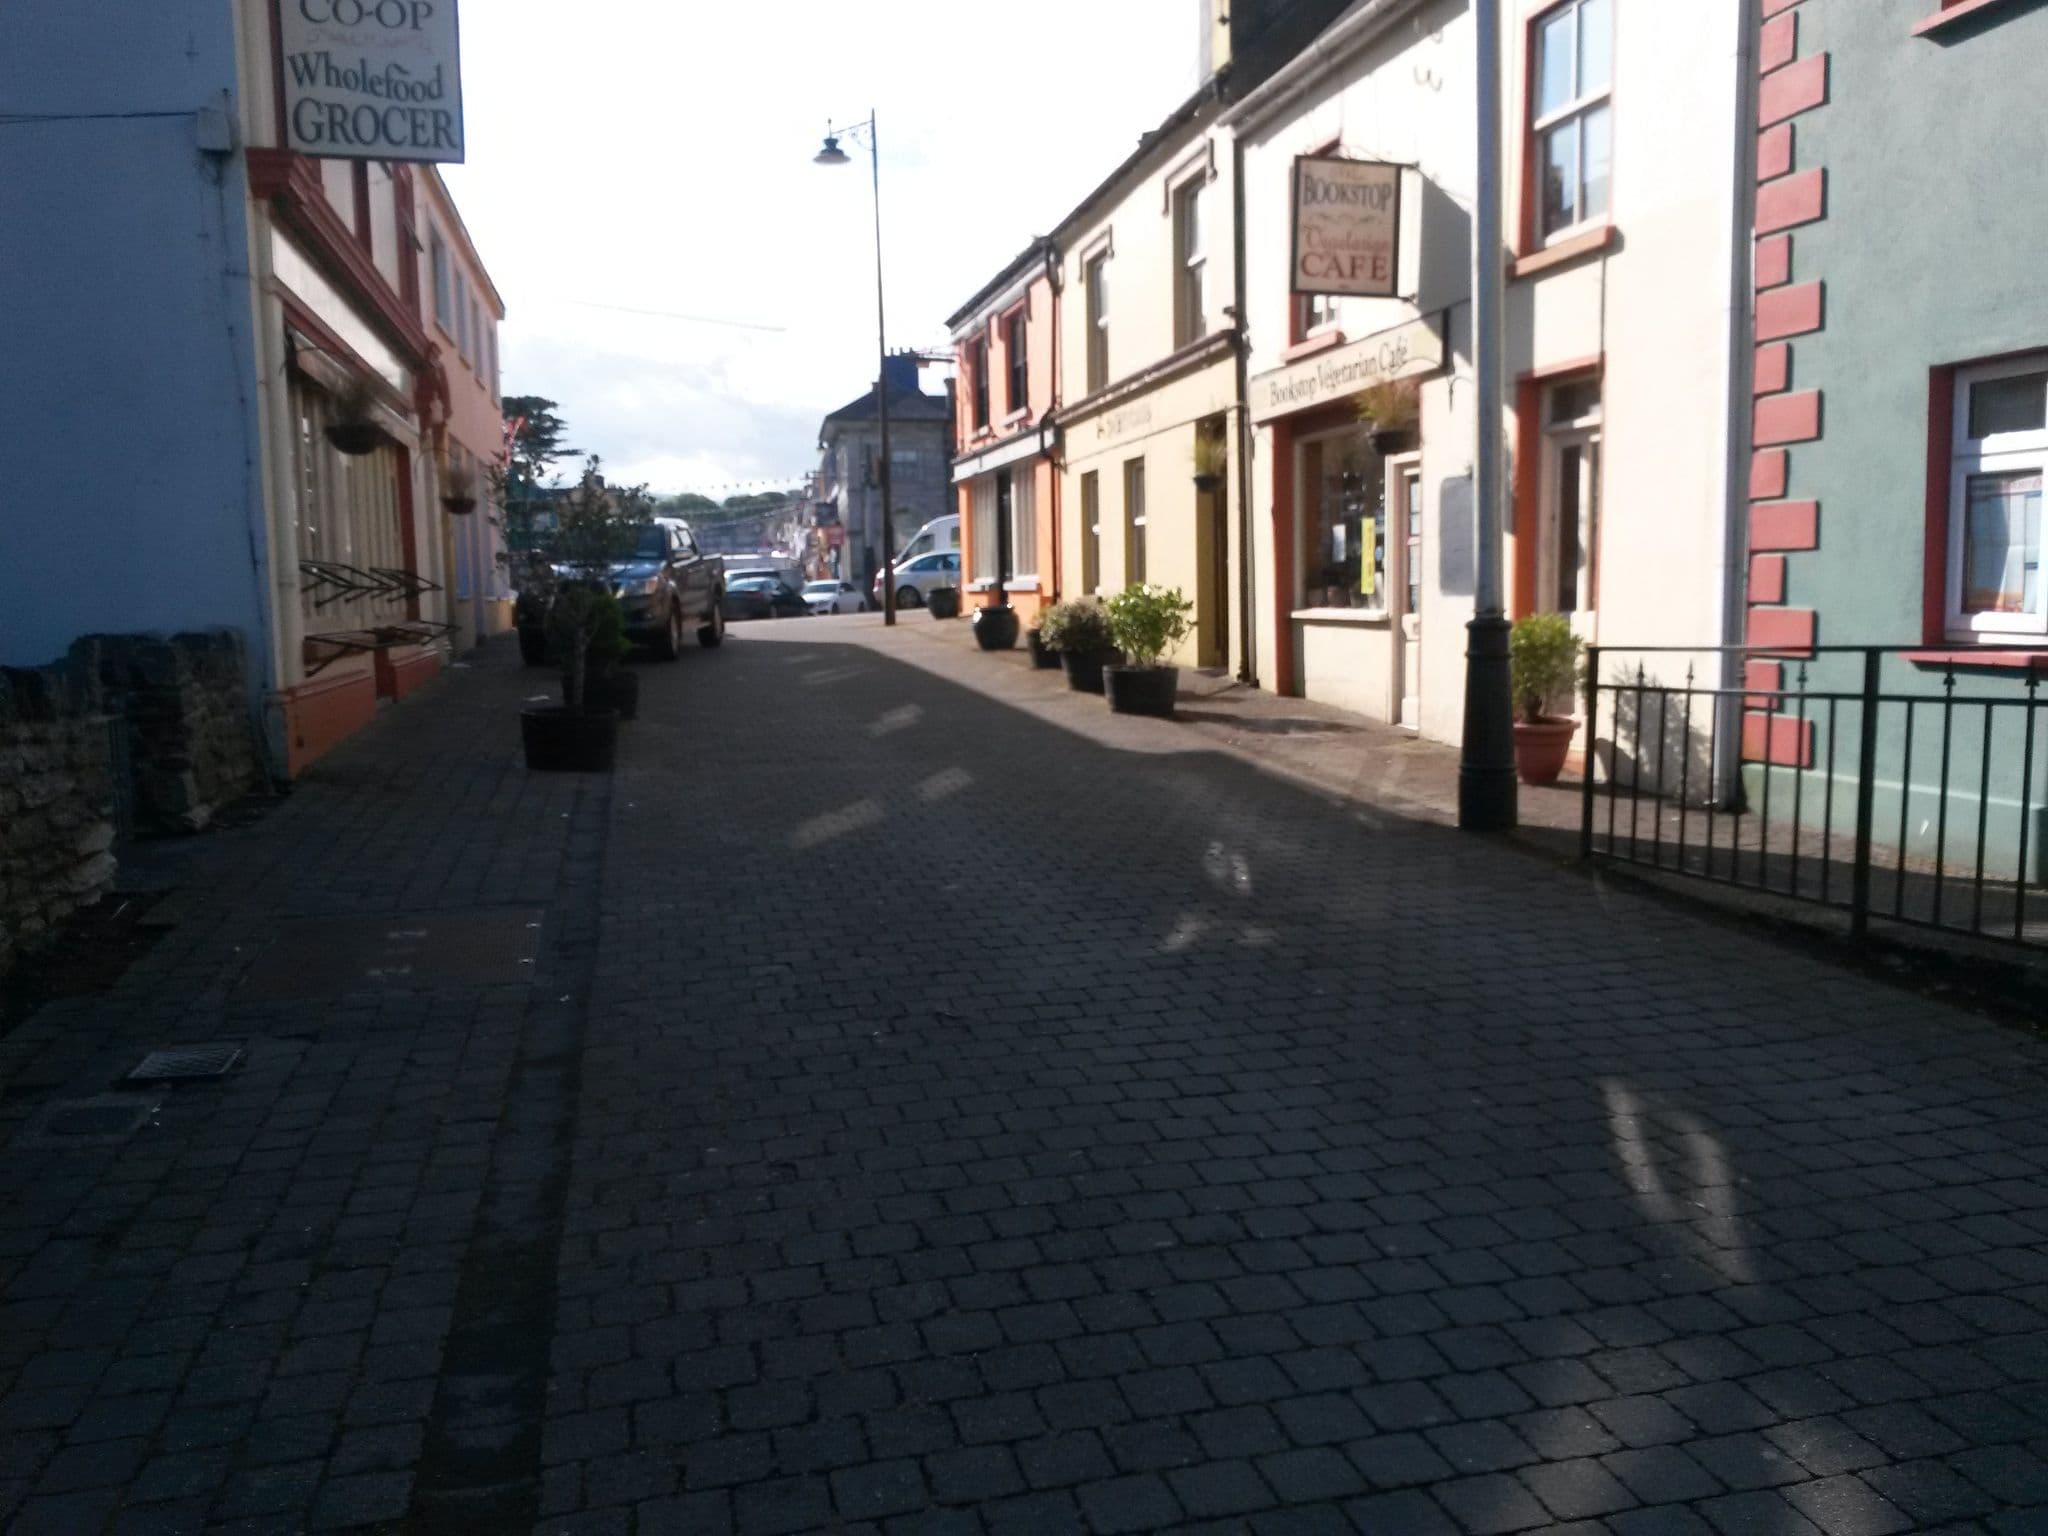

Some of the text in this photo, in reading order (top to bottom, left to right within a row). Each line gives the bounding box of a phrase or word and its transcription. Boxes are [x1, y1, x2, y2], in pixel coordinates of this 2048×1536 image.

[299, 0, 433, 30] CO-OP
[287, 51, 443, 102] Wholefood
[292, 97, 458, 149] GROCER
[1303, 174, 1393, 212] BOOKSTOP
